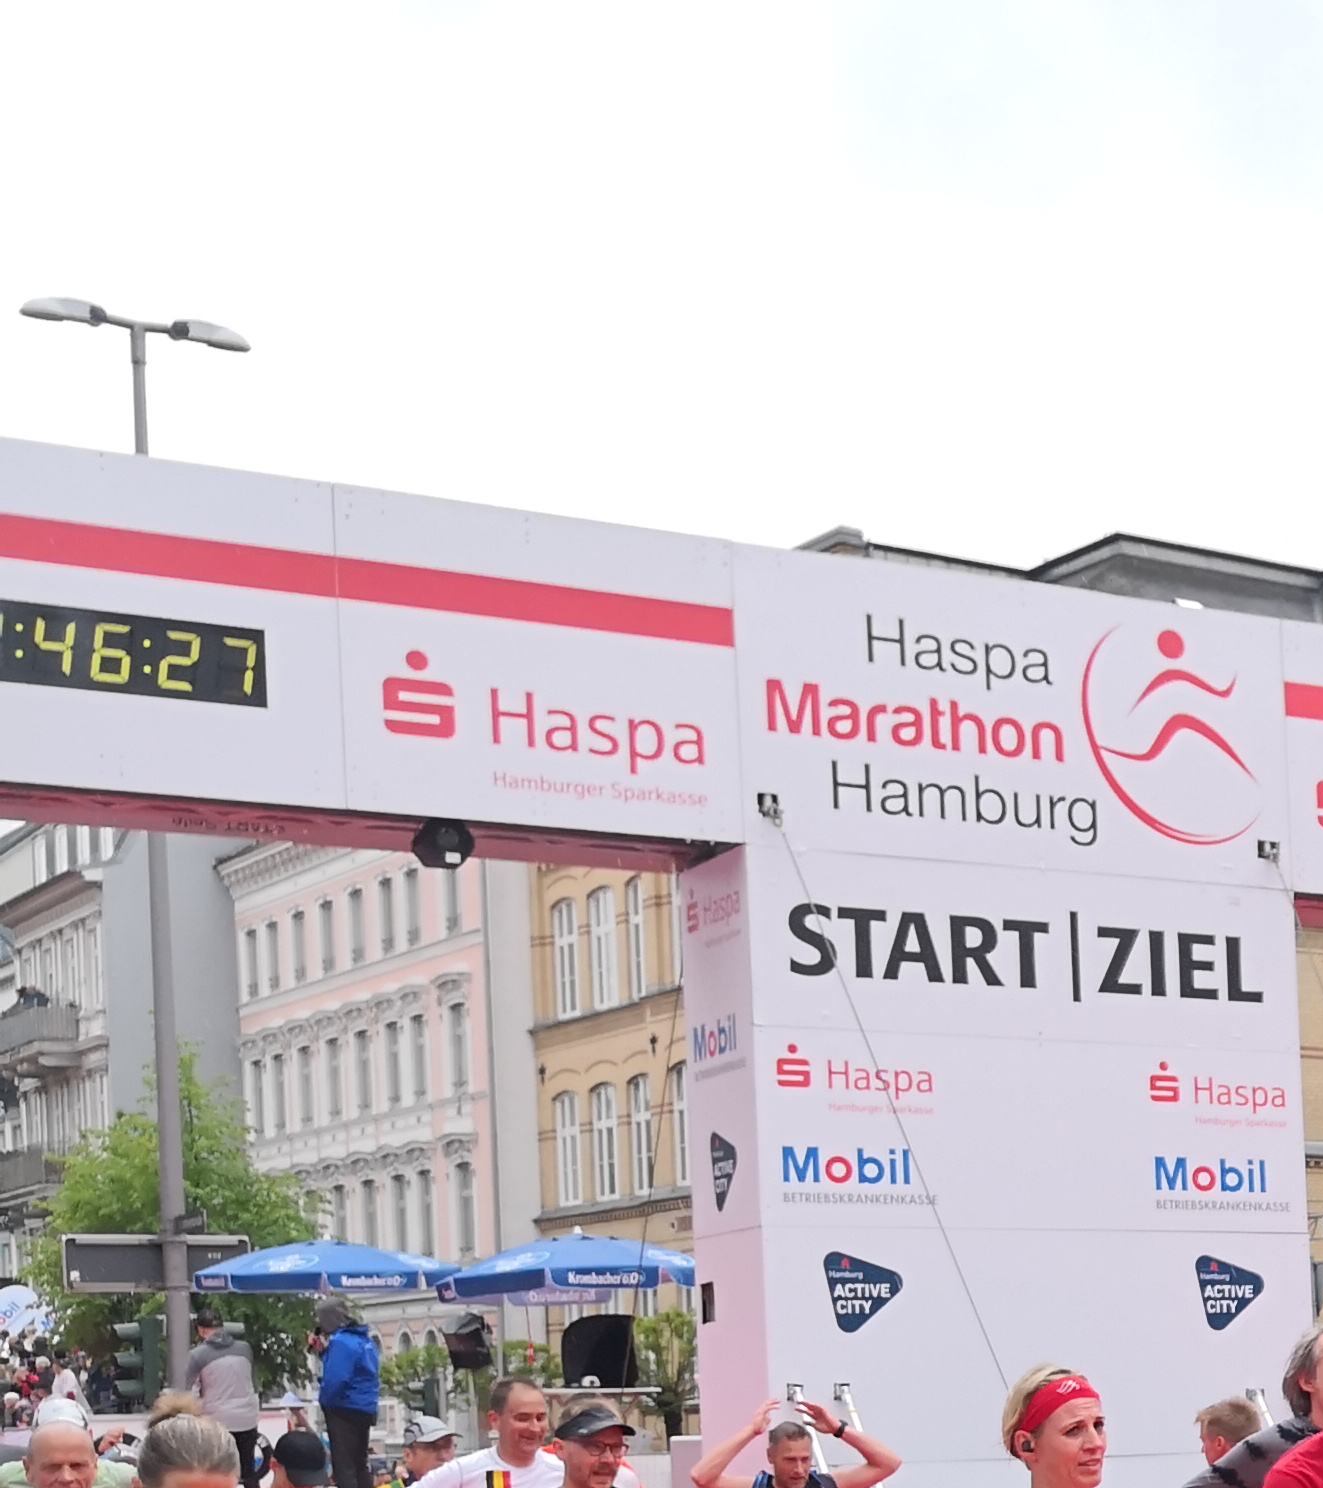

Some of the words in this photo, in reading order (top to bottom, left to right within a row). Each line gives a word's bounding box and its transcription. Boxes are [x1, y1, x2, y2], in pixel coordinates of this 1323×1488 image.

[0, 614, 257, 696] :46:27
[864, 613, 1054, 691] Haspa
[490, 687, 706, 775] Haspa
[765, 678, 1065, 763] Marathon
[493, 771, 604, 800] Hamburger
[610, 781, 708, 806] Sparkasse
[831, 759, 1099, 848] Hamburg
[787, 902, 1049, 989] START
[1097, 925, 1264, 1003] ZIEL
[694, 1013, 737, 1062] Mobil
[827, 1058, 934, 1099] Haspa
[1194, 1075, 1287, 1114] Haspa
[781, 1145, 911, 1186] Mobil
[1154, 1155, 1267, 1195] Mobil
[783, 1192, 938, 1206] BETRIEBSKRANKENKASSE
[1155, 1200, 1291, 1213] BETRIEBSKRANKENKASSE
[833, 1282, 891, 1299] ACTIVE
[836, 1297, 872, 1315] CITY
[1204, 1284, 1254, 1299] ACTIVE
[1206, 1298, 1238, 1315] CITY
